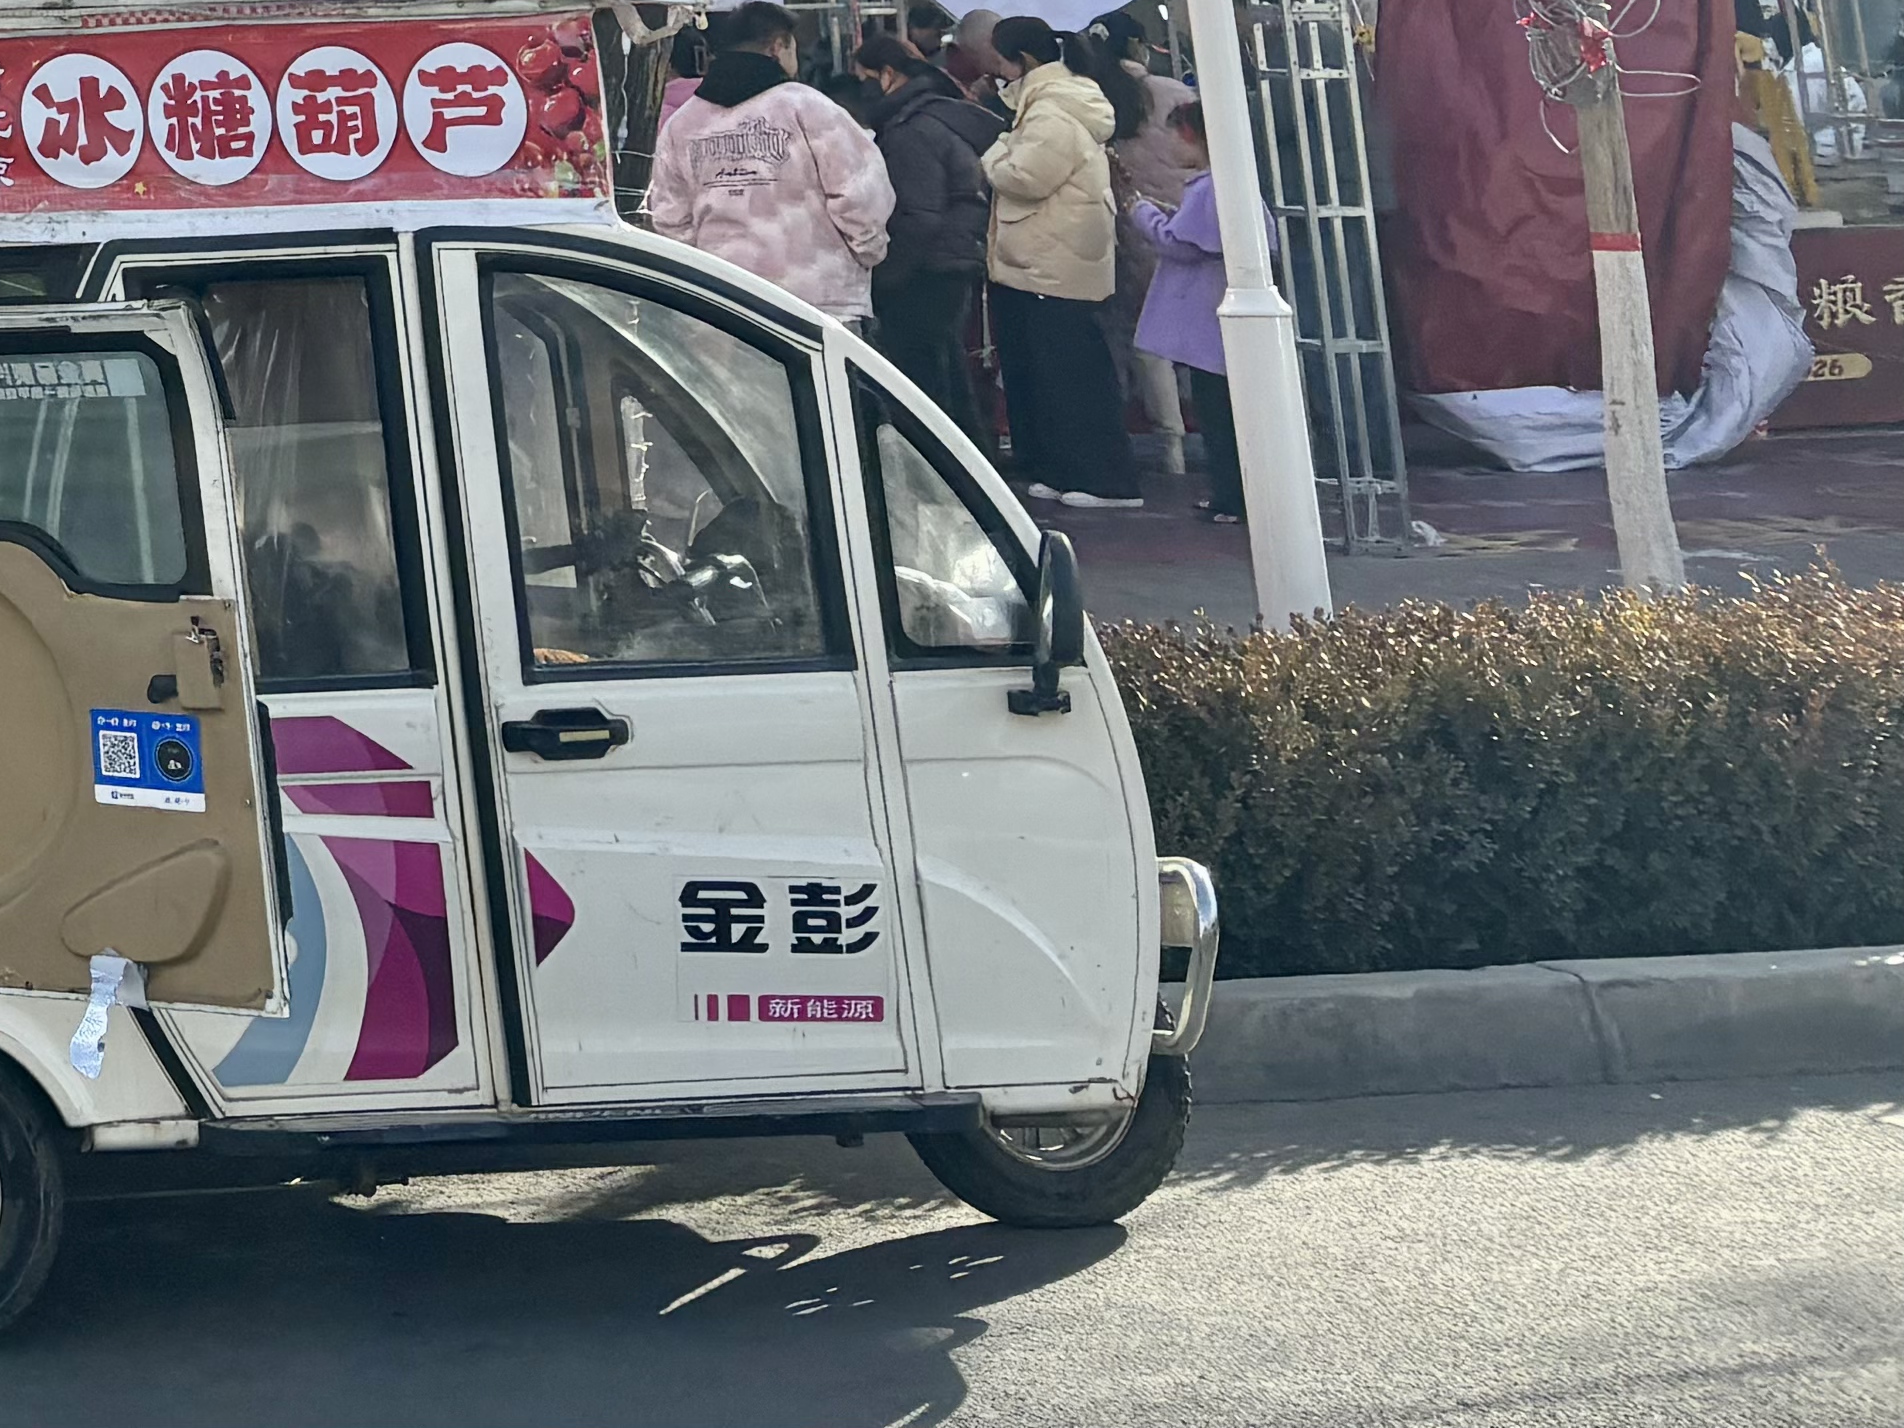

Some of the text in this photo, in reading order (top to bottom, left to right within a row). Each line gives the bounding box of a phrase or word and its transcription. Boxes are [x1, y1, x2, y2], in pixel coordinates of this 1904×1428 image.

[27, 61, 508, 172] 冰糖葫芦
[678, 879, 881, 955] 金彭
[768, 997, 876, 1020] 新能源
